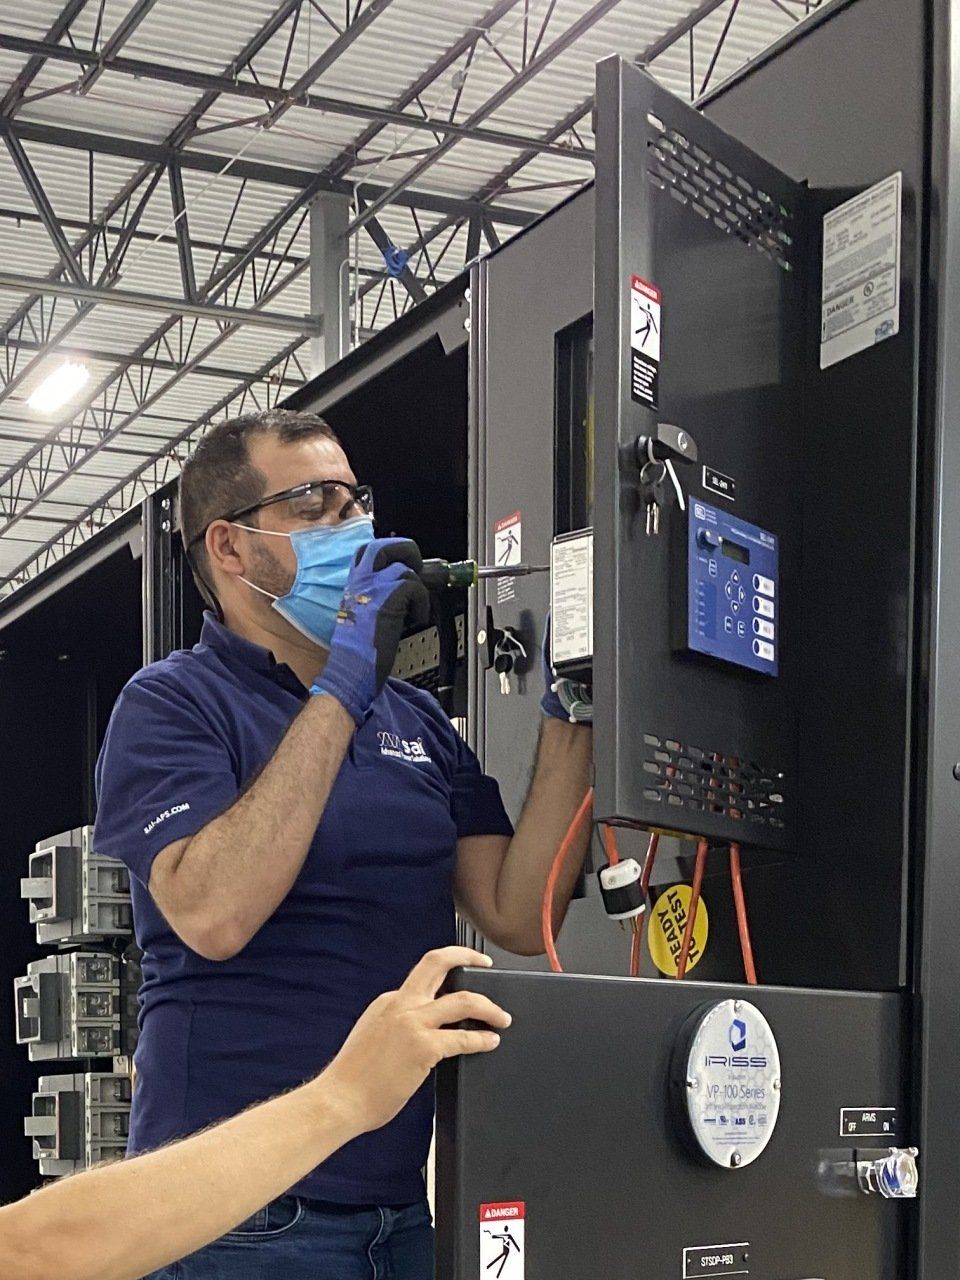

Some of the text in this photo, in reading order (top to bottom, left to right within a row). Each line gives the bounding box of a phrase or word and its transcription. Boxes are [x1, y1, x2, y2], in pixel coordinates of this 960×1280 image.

[667, 889, 688, 934] TEST
[705, 1056, 767, 1067] IRISS
[707, 1084, 766, 1099] VP-100 Series
[490, 1207, 519, 1217] DANGER
